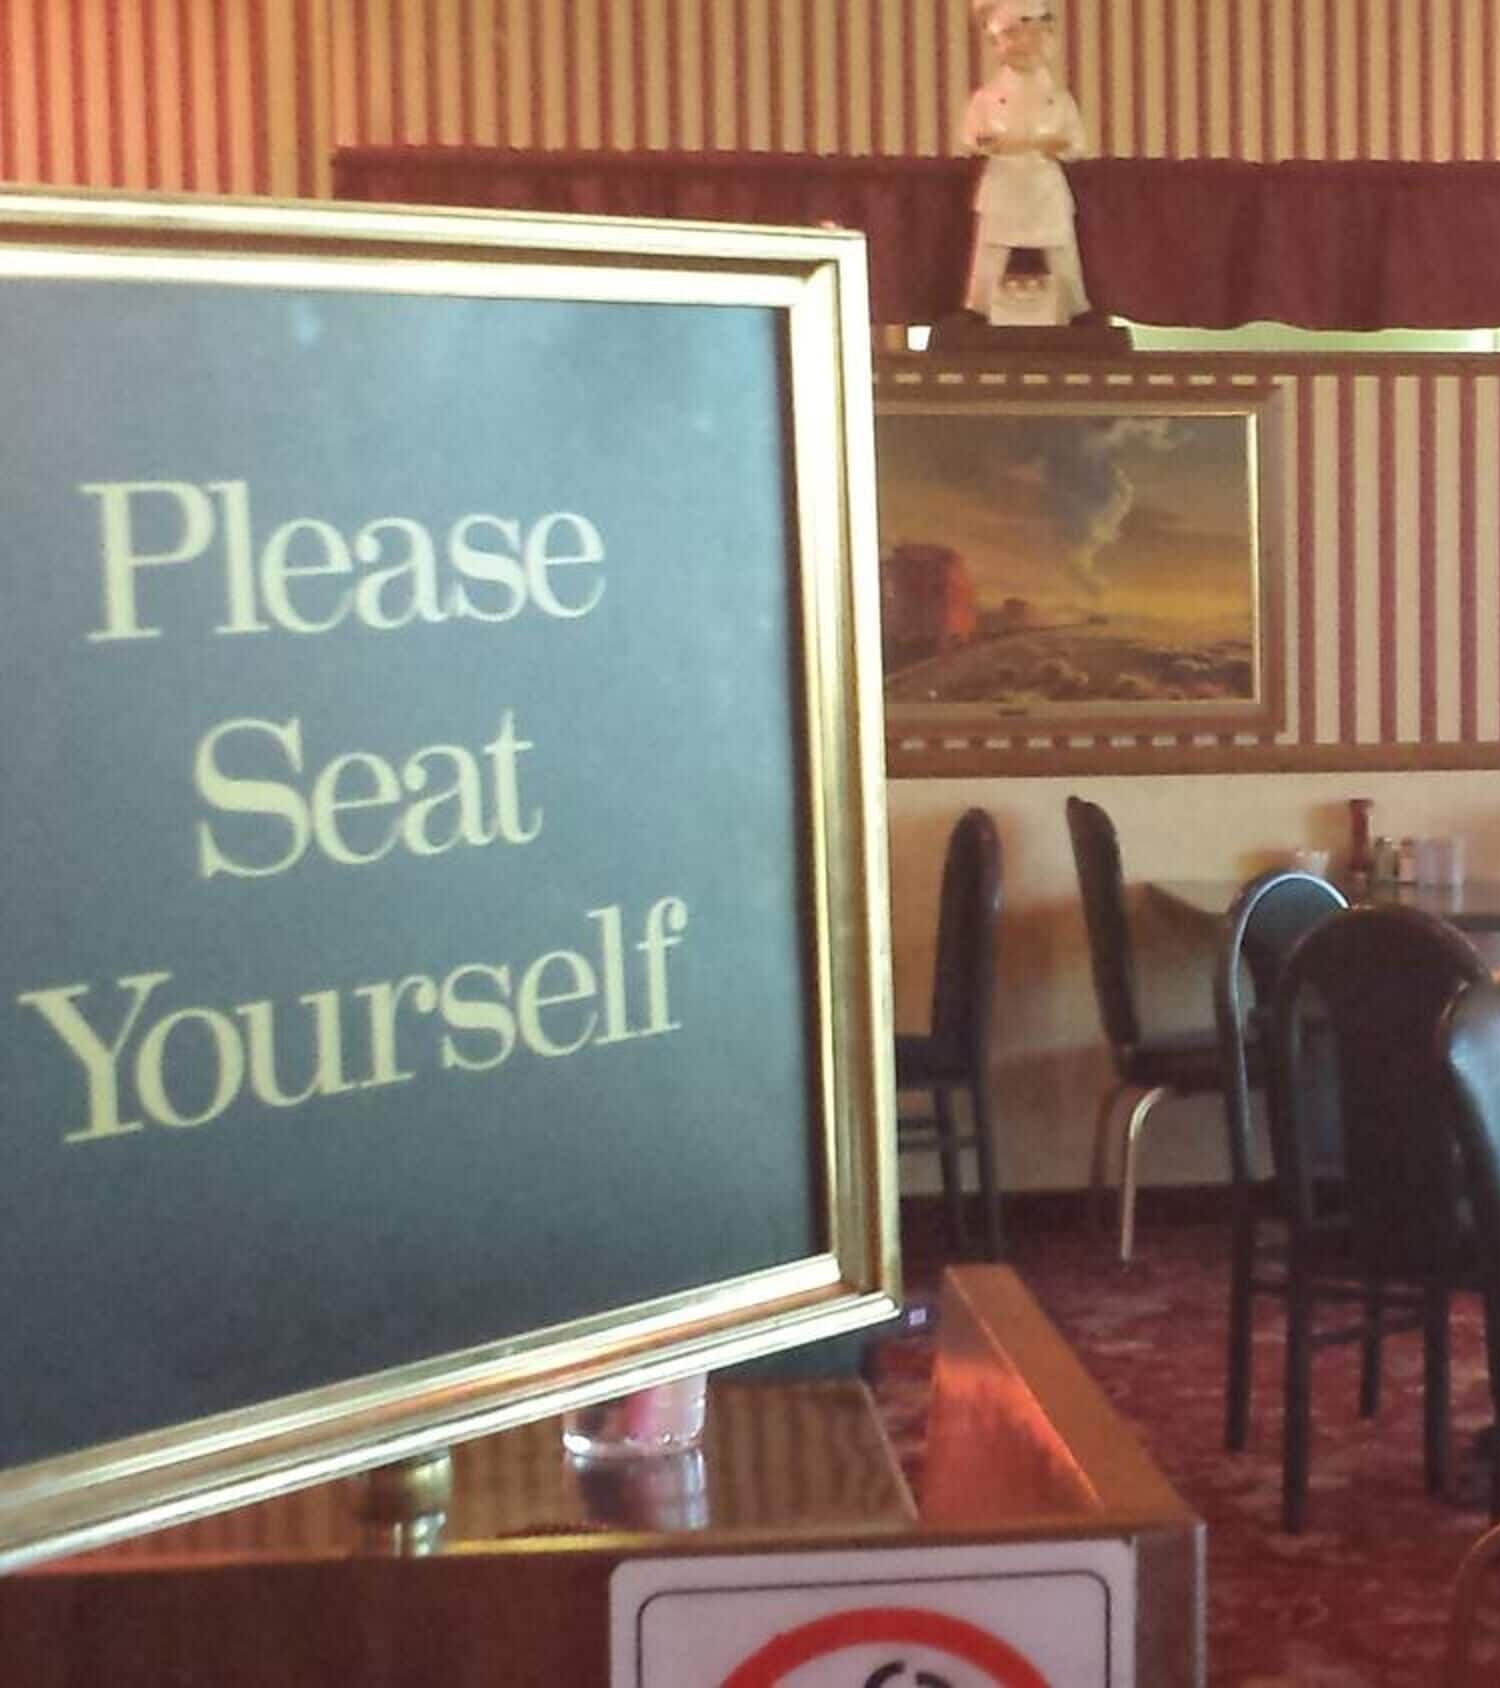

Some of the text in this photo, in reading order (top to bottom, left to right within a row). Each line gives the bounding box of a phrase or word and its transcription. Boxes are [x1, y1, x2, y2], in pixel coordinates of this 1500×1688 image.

[79, 478, 606, 643] Please
[194, 709, 544, 878] Seat
[17, 896, 689, 1146] Yourself
